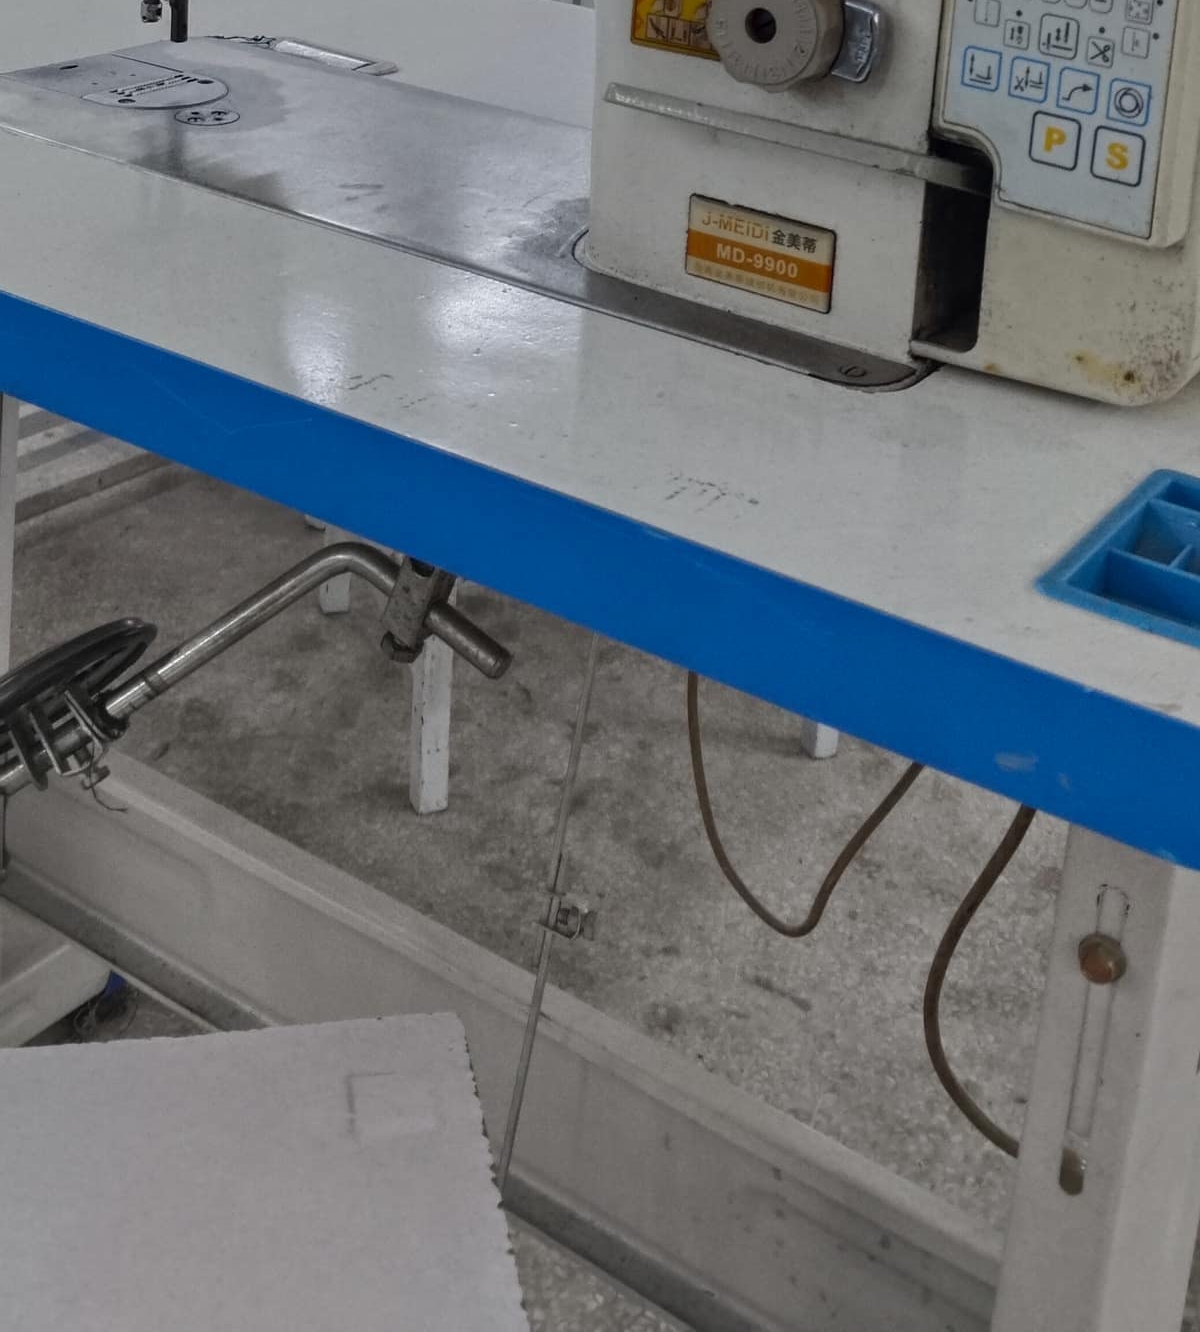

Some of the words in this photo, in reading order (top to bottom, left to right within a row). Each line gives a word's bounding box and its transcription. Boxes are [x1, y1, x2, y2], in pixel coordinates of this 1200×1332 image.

[1043, 126, 1066, 152] P
[1105, 142, 1129, 170] S
[716, 243, 798, 278] MD-9900
